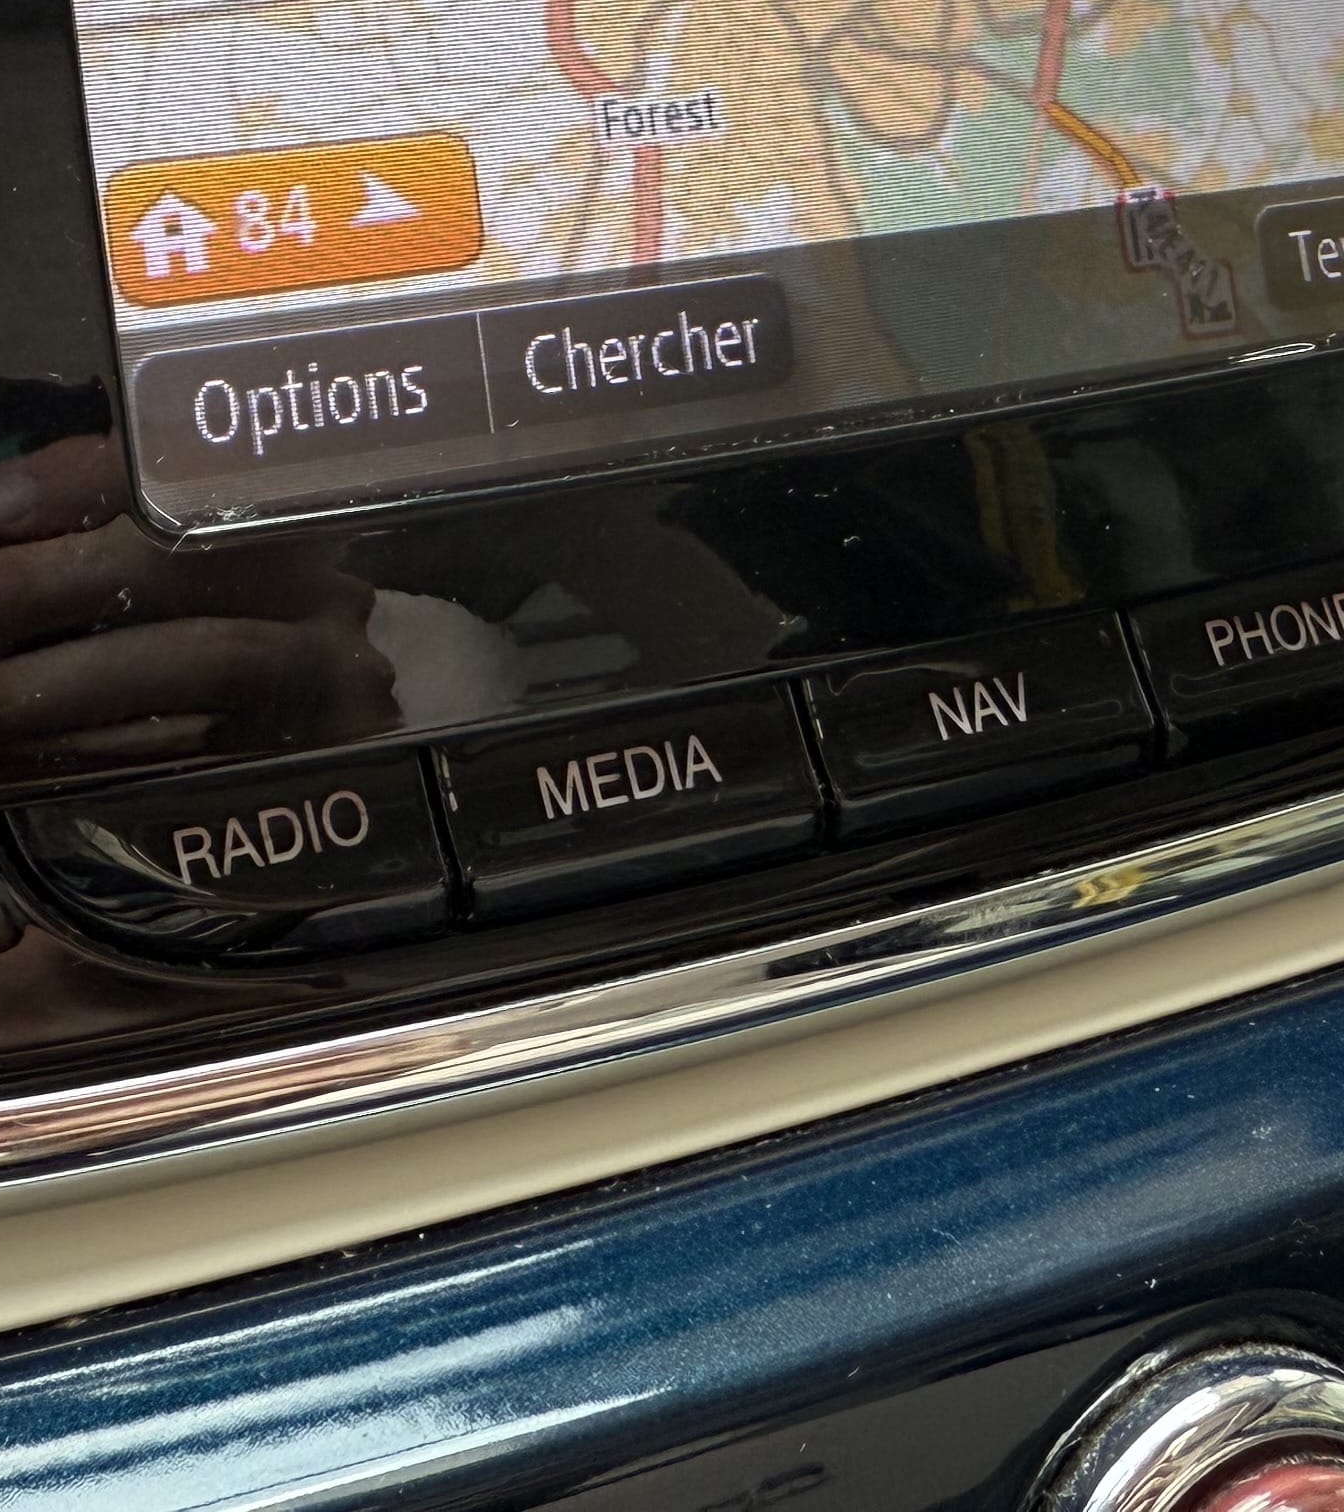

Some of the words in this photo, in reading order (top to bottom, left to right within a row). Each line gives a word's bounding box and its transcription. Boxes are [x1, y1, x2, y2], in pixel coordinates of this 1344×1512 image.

[601, 91, 720, 138] Forest
[233, 183, 317, 254] 84
[524, 310, 760, 394] Chercher
[193, 362, 430, 456] Options
[928, 672, 1029, 741] NAV
[536, 734, 723, 820] MEDIA
[173, 790, 369, 884] RADIO
